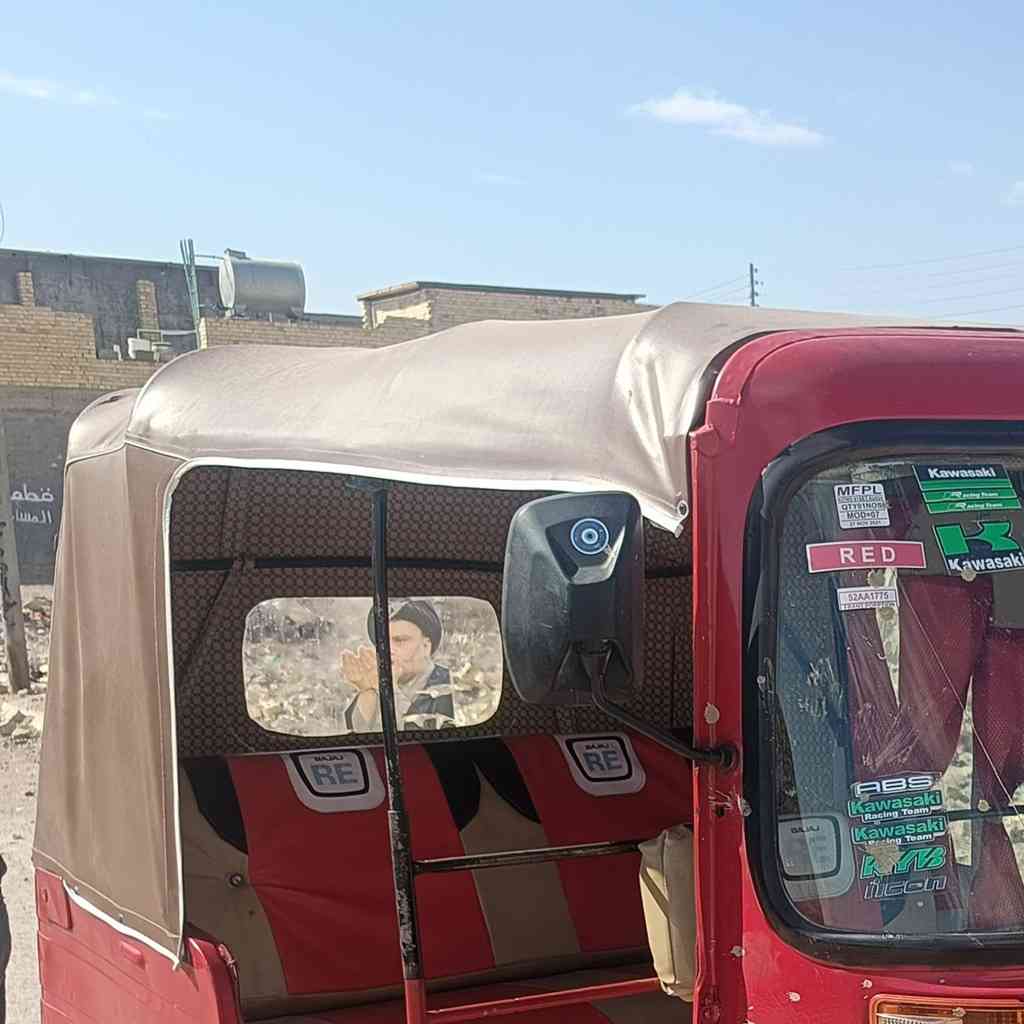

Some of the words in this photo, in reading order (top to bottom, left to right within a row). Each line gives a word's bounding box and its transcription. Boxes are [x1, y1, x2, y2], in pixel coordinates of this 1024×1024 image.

[927, 467, 997, 478] Kawasaki
[837, 485, 881, 496] MFPL
[839, 546, 896, 564] RED
[582, 750, 623, 770] RE
[311, 763, 358, 785] RE
[857, 776, 933, 794] ABS
[850, 791, 941, 815] Kawasaki
[864, 810, 898, 821] Racing
[901, 807, 929, 816] Team
[854, 818, 944, 841] Kawasaki
[904, 833, 932, 842] Team
